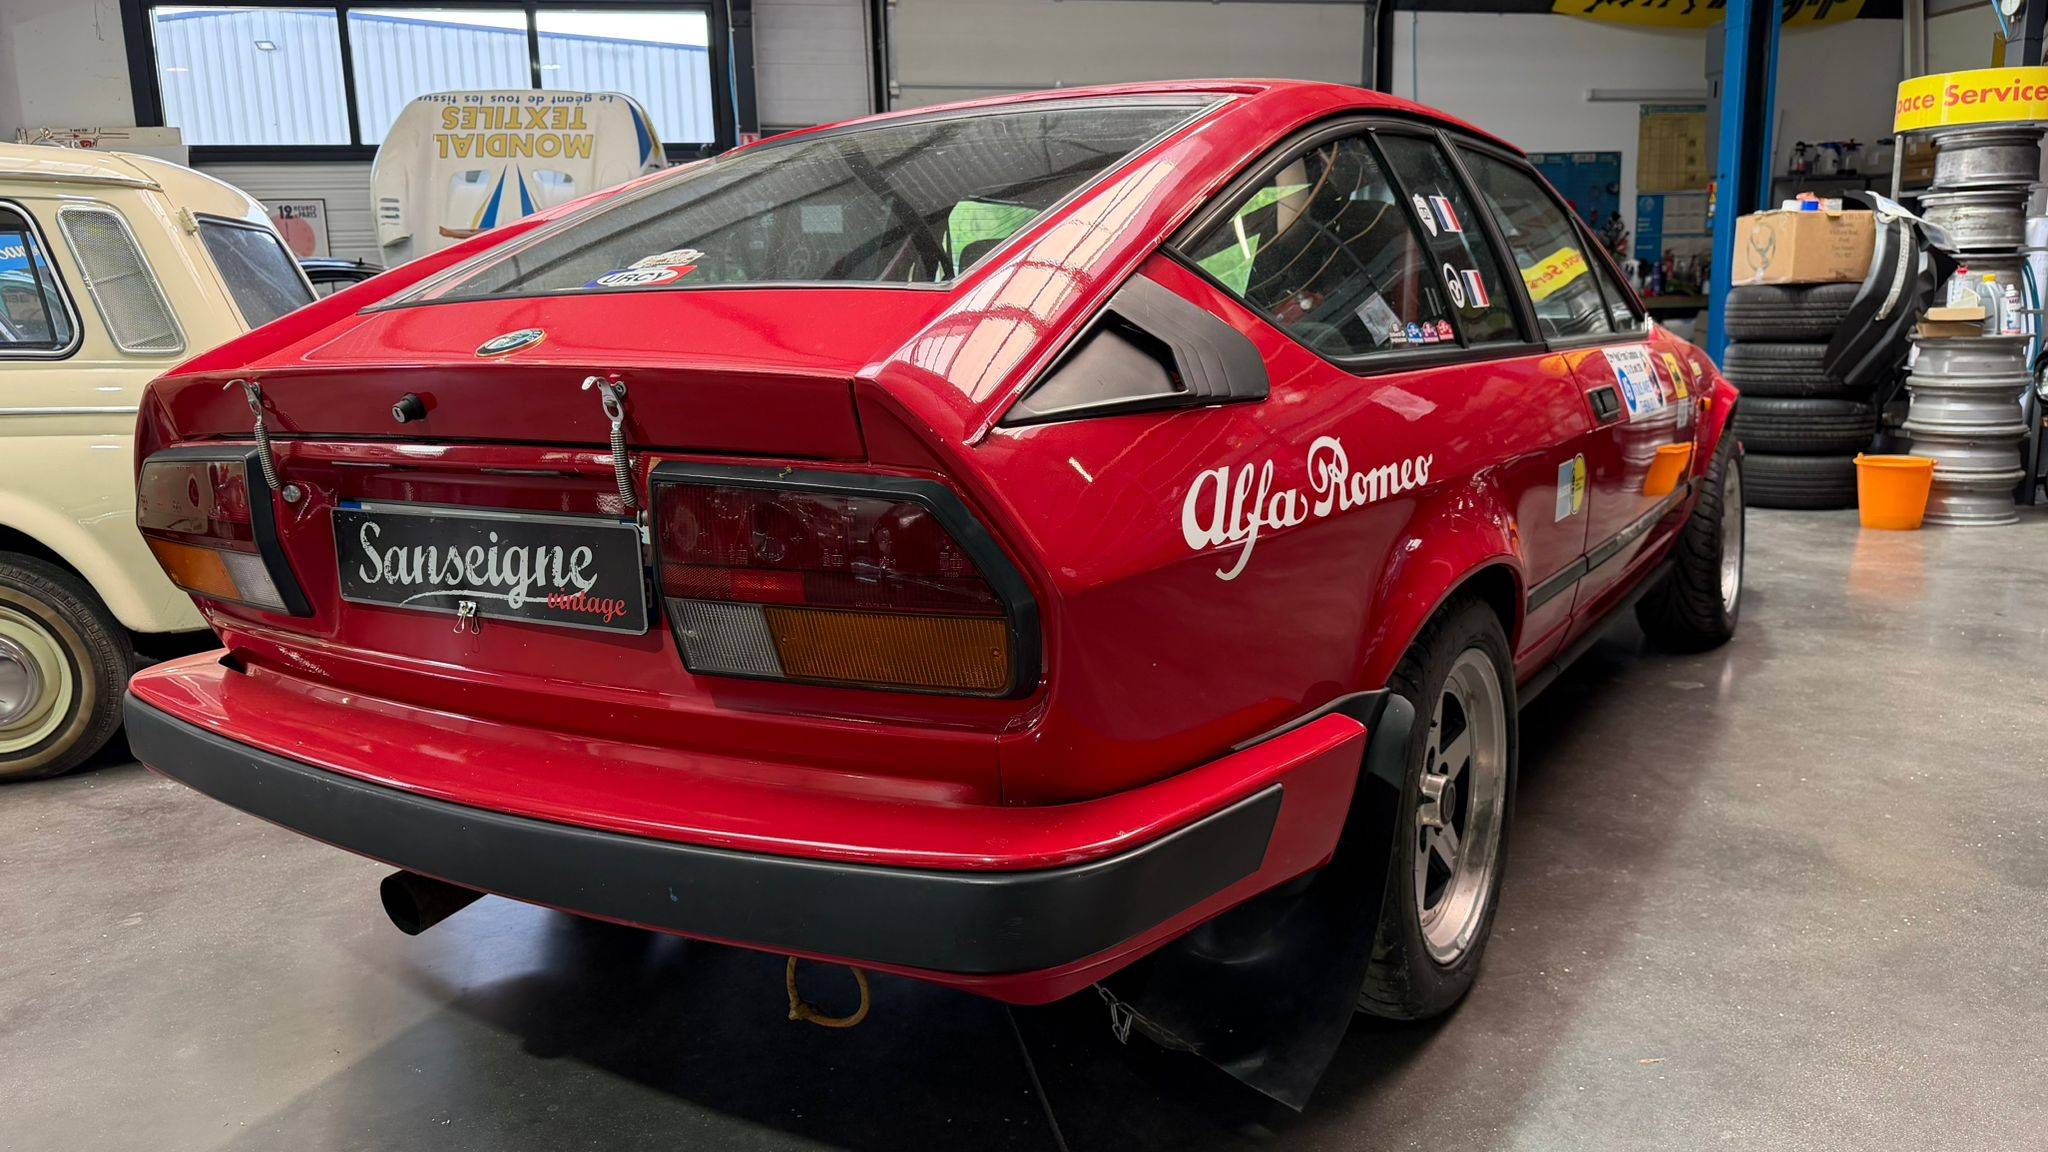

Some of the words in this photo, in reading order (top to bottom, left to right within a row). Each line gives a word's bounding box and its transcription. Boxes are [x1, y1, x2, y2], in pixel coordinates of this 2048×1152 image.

[464, 95, 484, 105] les
[490, 95, 519, 104] tous
[528, 95, 545, 106] de
[551, 94, 592, 106] géant
[599, 95, 614, 103] Le
[1944, 78, 2048, 107] Service
[441, 106, 588, 130] TEXTILES
[433, 133, 594, 158] MONDIAL
[278, 205, 293, 219] 12
[1182, 459, 1308, 581] Alfa
[1307, 436, 1434, 517] Romeo
[359, 521, 598, 608] Sanseigne
[547, 587, 628, 623] vintage
